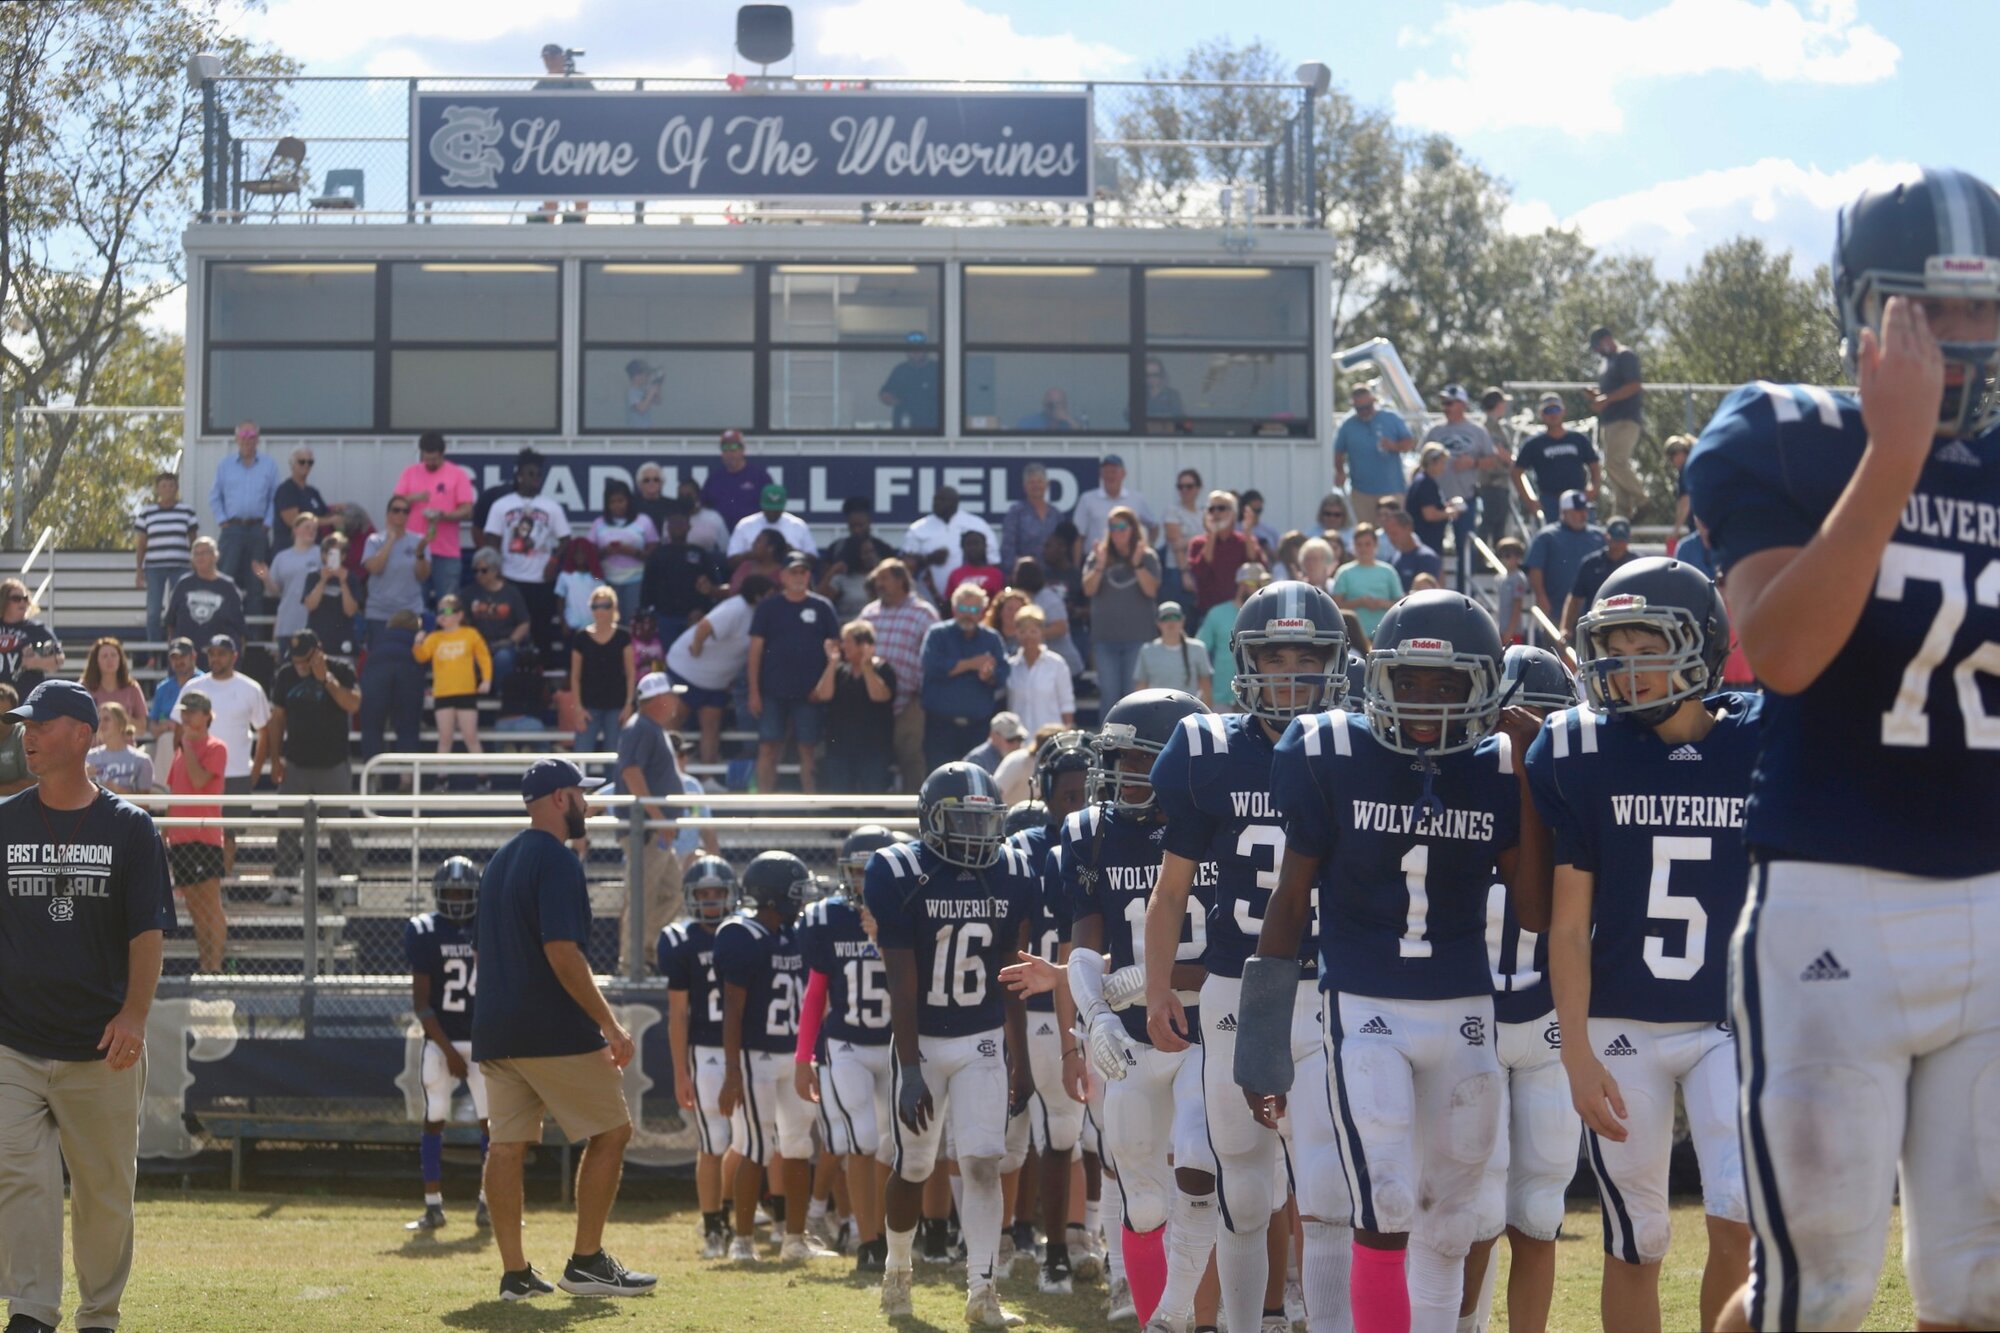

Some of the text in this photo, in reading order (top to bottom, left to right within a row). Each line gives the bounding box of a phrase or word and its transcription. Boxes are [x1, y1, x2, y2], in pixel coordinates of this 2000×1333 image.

[510, 115, 1079, 189] Home Of The Wolverines
[873, 466, 1079, 514] FIELD
[1901, 492, 2000, 547] OLVER
[1277, 618, 1304, 628] Riddell
[1411, 639, 1442, 650] Riddell
[1668, 752, 1703, 761] adidas
[1352, 800, 1495, 842] WOLVERINES
[1611, 794, 1747, 828] WOLVERINE
[7, 844, 112, 865] EAST CLARENDON
[7, 877, 110, 897] FOOTBALL
[1399, 844, 1433, 958] 1
[1643, 835, 1712, 981] 5
[926, 921, 994, 1008] 16
[843, 959, 892, 1028] 15
[1359, 1026, 1393, 1036] adidas
[1604, 1048, 1637, 1056] adidas
